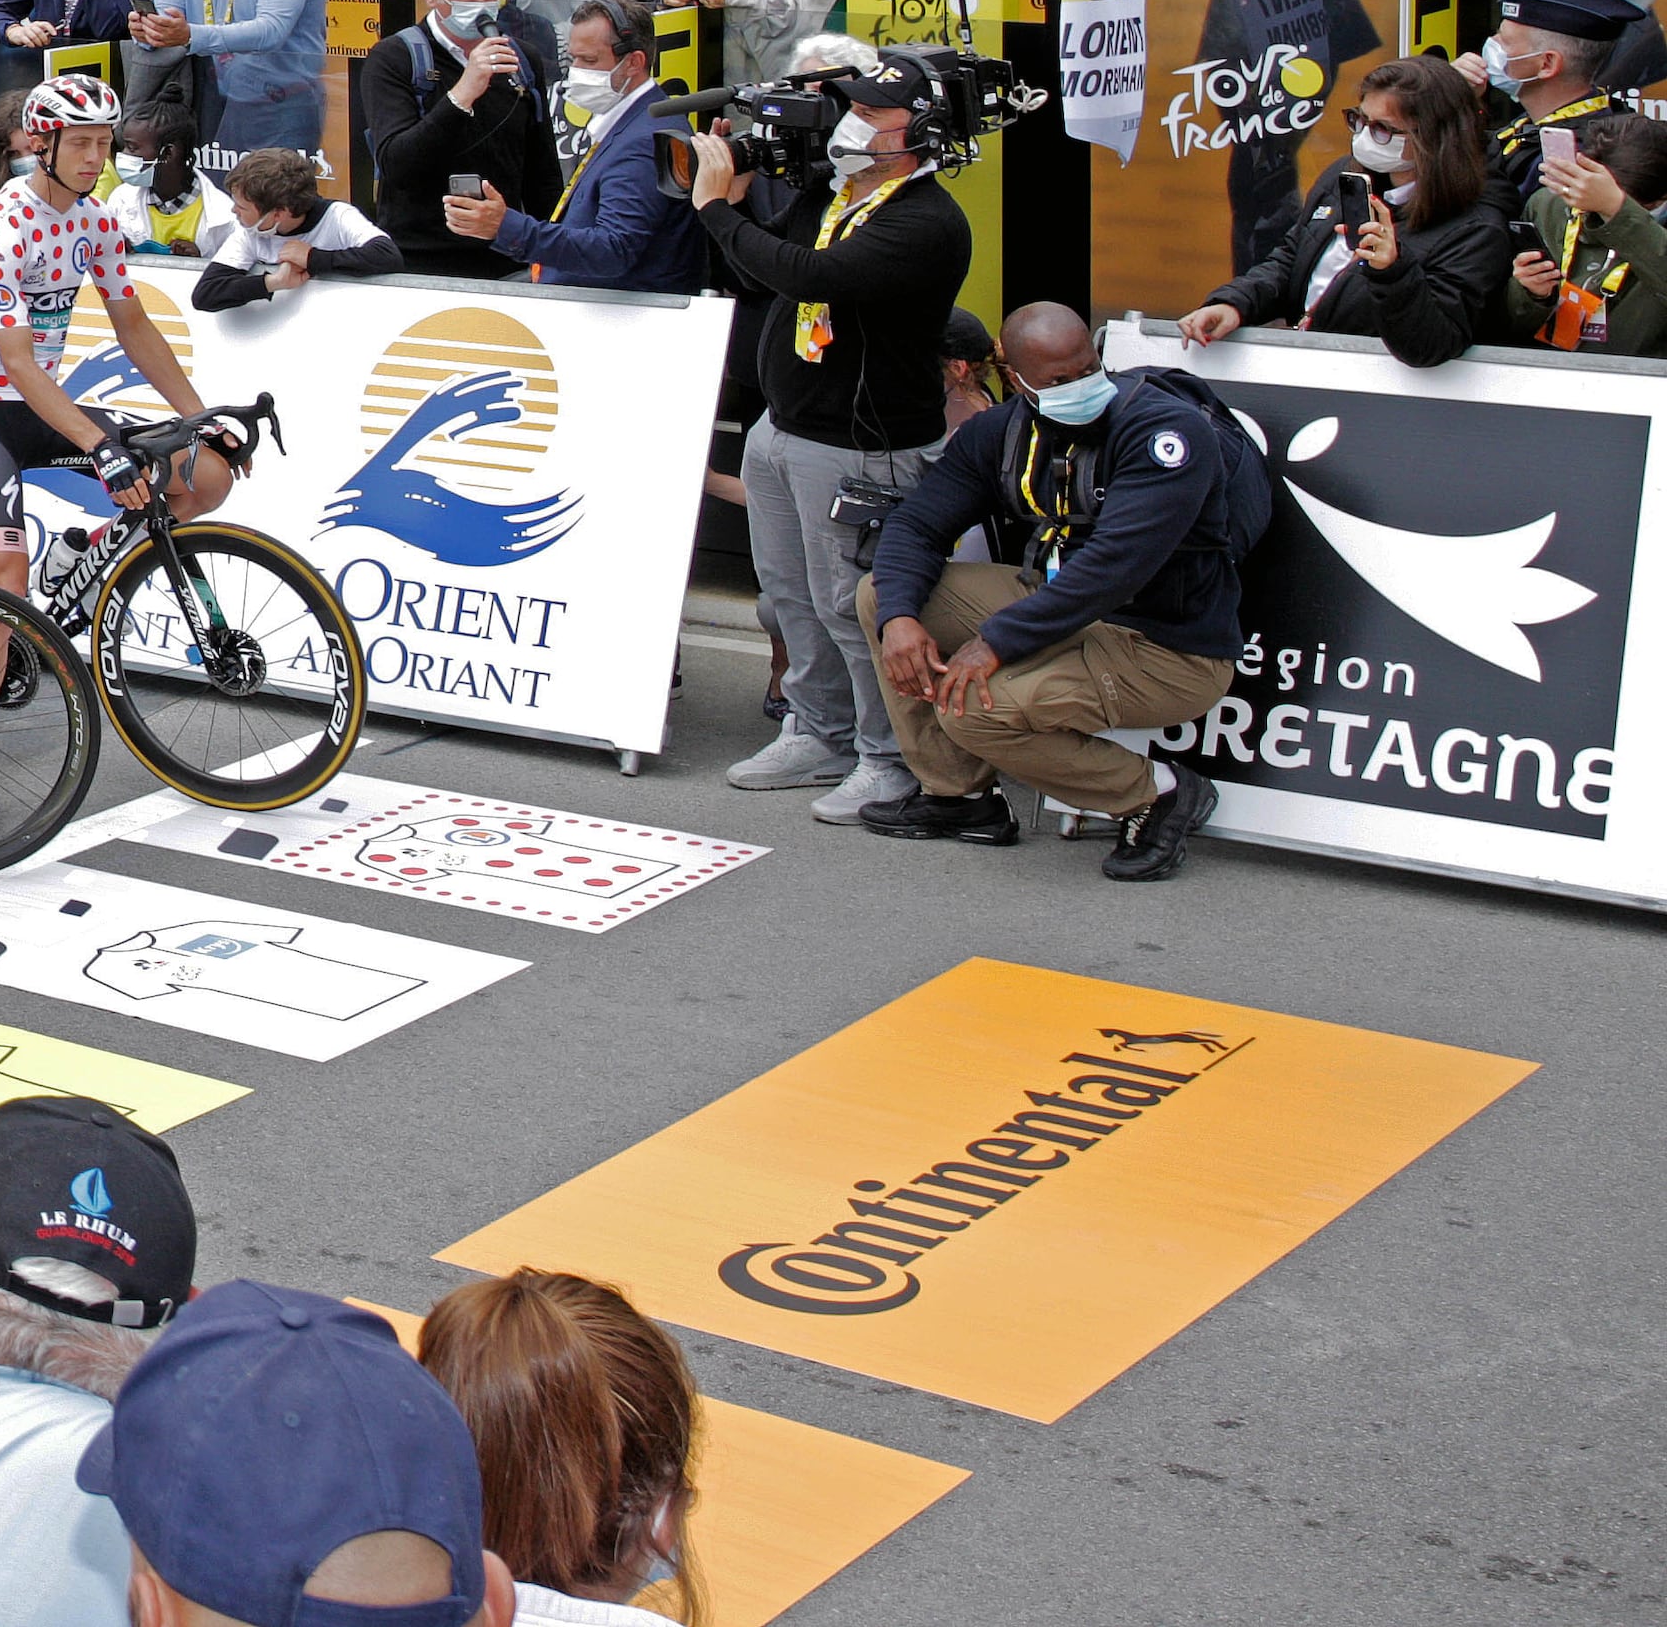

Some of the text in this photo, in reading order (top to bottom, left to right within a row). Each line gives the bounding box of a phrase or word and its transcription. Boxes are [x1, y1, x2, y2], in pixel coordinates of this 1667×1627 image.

[1172, 43, 1308, 114] TOUR
[1261, 84, 1284, 108] de
[1160, 92, 1323, 159] france
[322, 558, 567, 649] ORIENT
[101, 586, 124, 697] roval
[367, 635, 551, 708] ORIANT
[324, 629, 349, 746] roval
[717, 1052, 1203, 1316] Continental
[40, 1210, 138, 1251] LE RHUM
